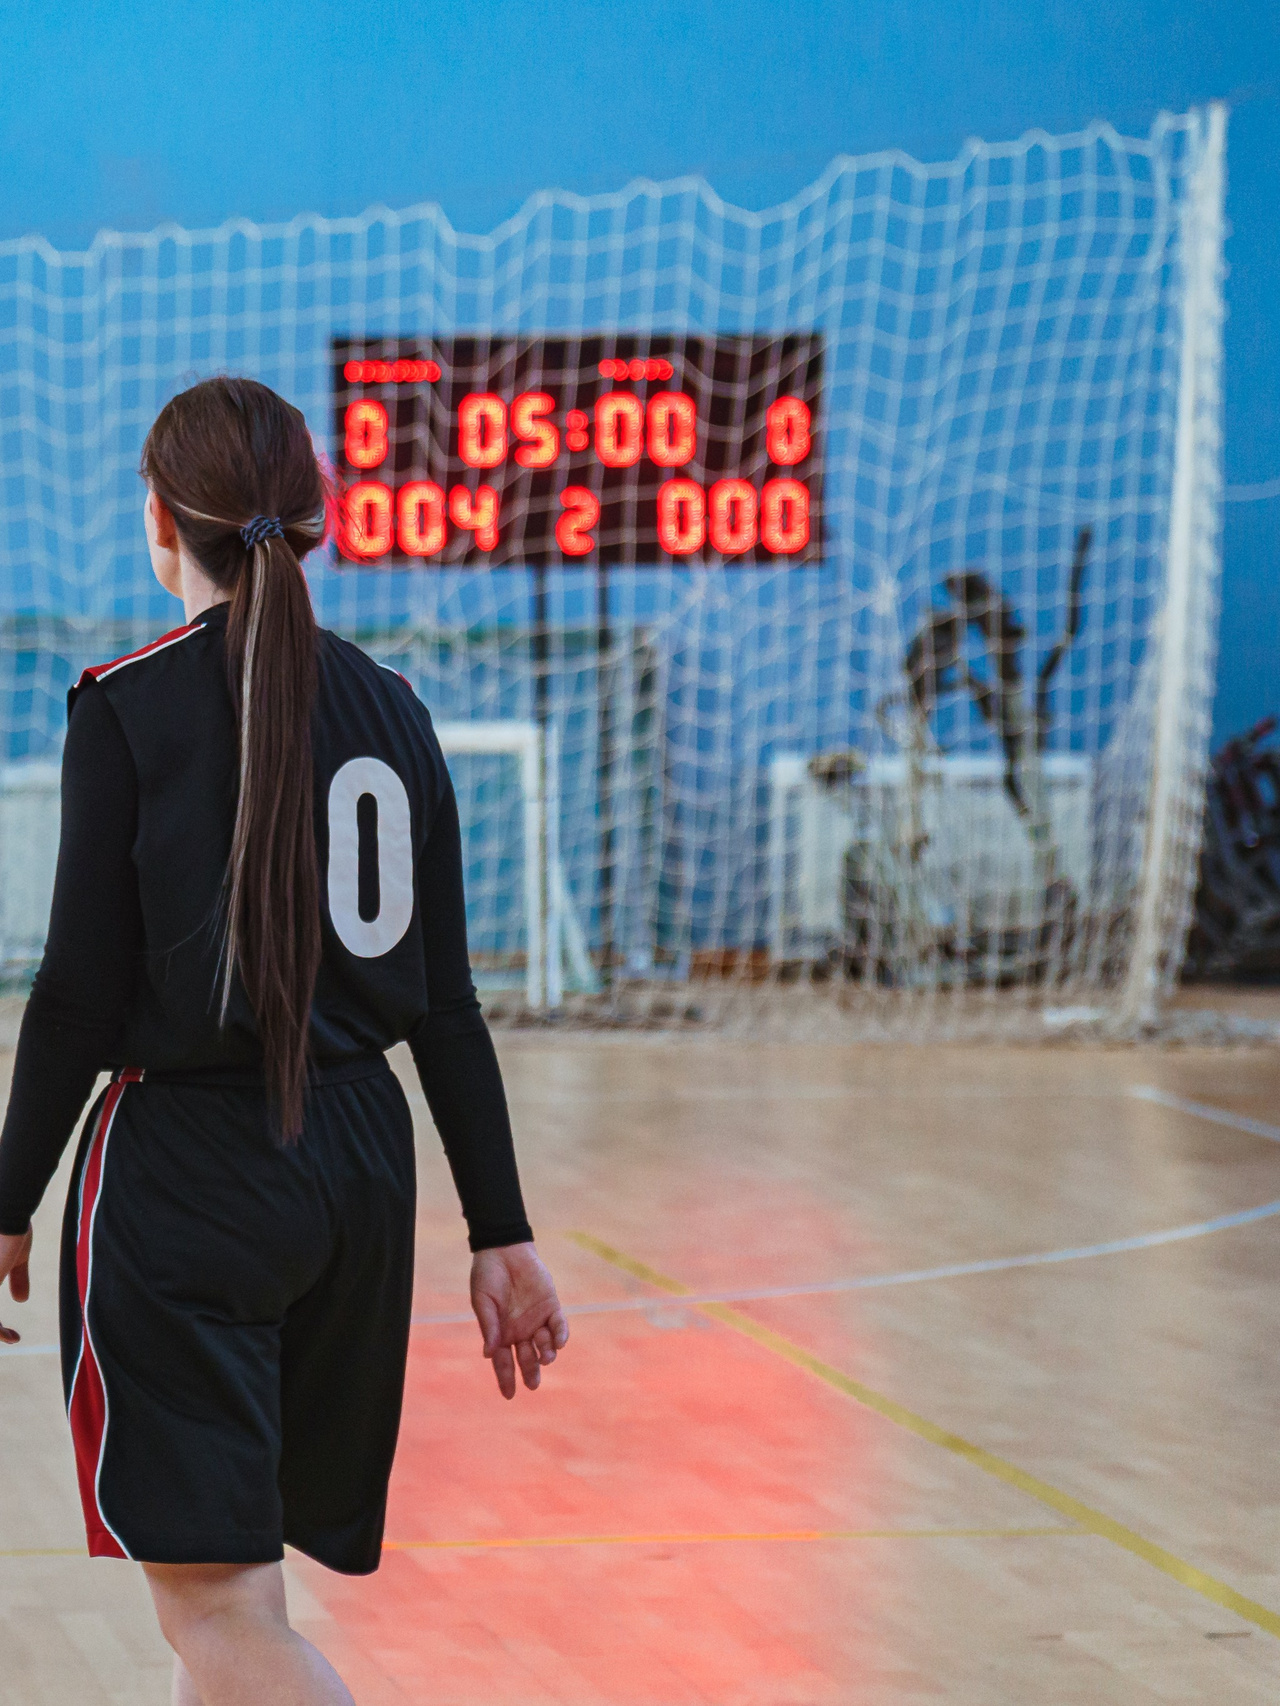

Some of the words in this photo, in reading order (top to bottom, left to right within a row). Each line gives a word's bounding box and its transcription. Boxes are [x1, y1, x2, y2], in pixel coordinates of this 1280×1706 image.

[458, 391, 696, 468] 05:00
[766, 396, 811, 466] 0
[345, 481, 499, 556] 004
[555, 486, 600, 556] 2
[657, 478, 810, 554] 000
